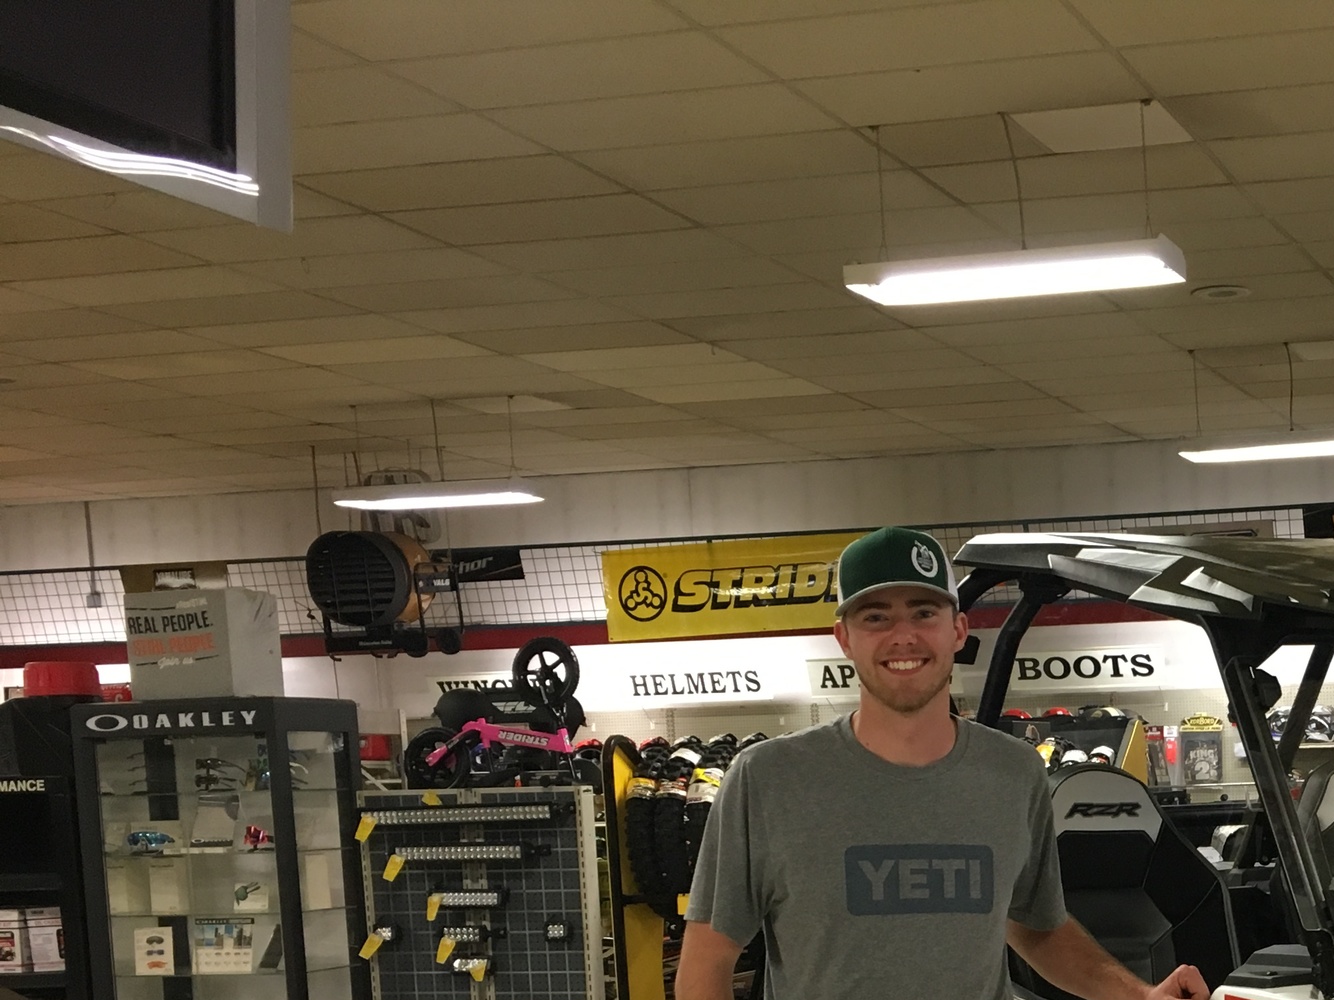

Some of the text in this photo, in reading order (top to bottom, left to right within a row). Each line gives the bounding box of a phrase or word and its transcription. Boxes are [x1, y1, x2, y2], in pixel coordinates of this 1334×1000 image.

[458, 556, 493, 574] hor
[671, 562, 839, 613] STRID
[128, 610, 213, 635] REAL PEOPLE.
[1016, 654, 1155, 681] BOOTS
[630, 671, 761, 696] HELMETS
[132, 710, 257, 729] OAKLEY
[498, 729, 549, 746] STRIDER
[1064, 802, 1142, 819] RZR
[857, 859, 984, 900] YETI
